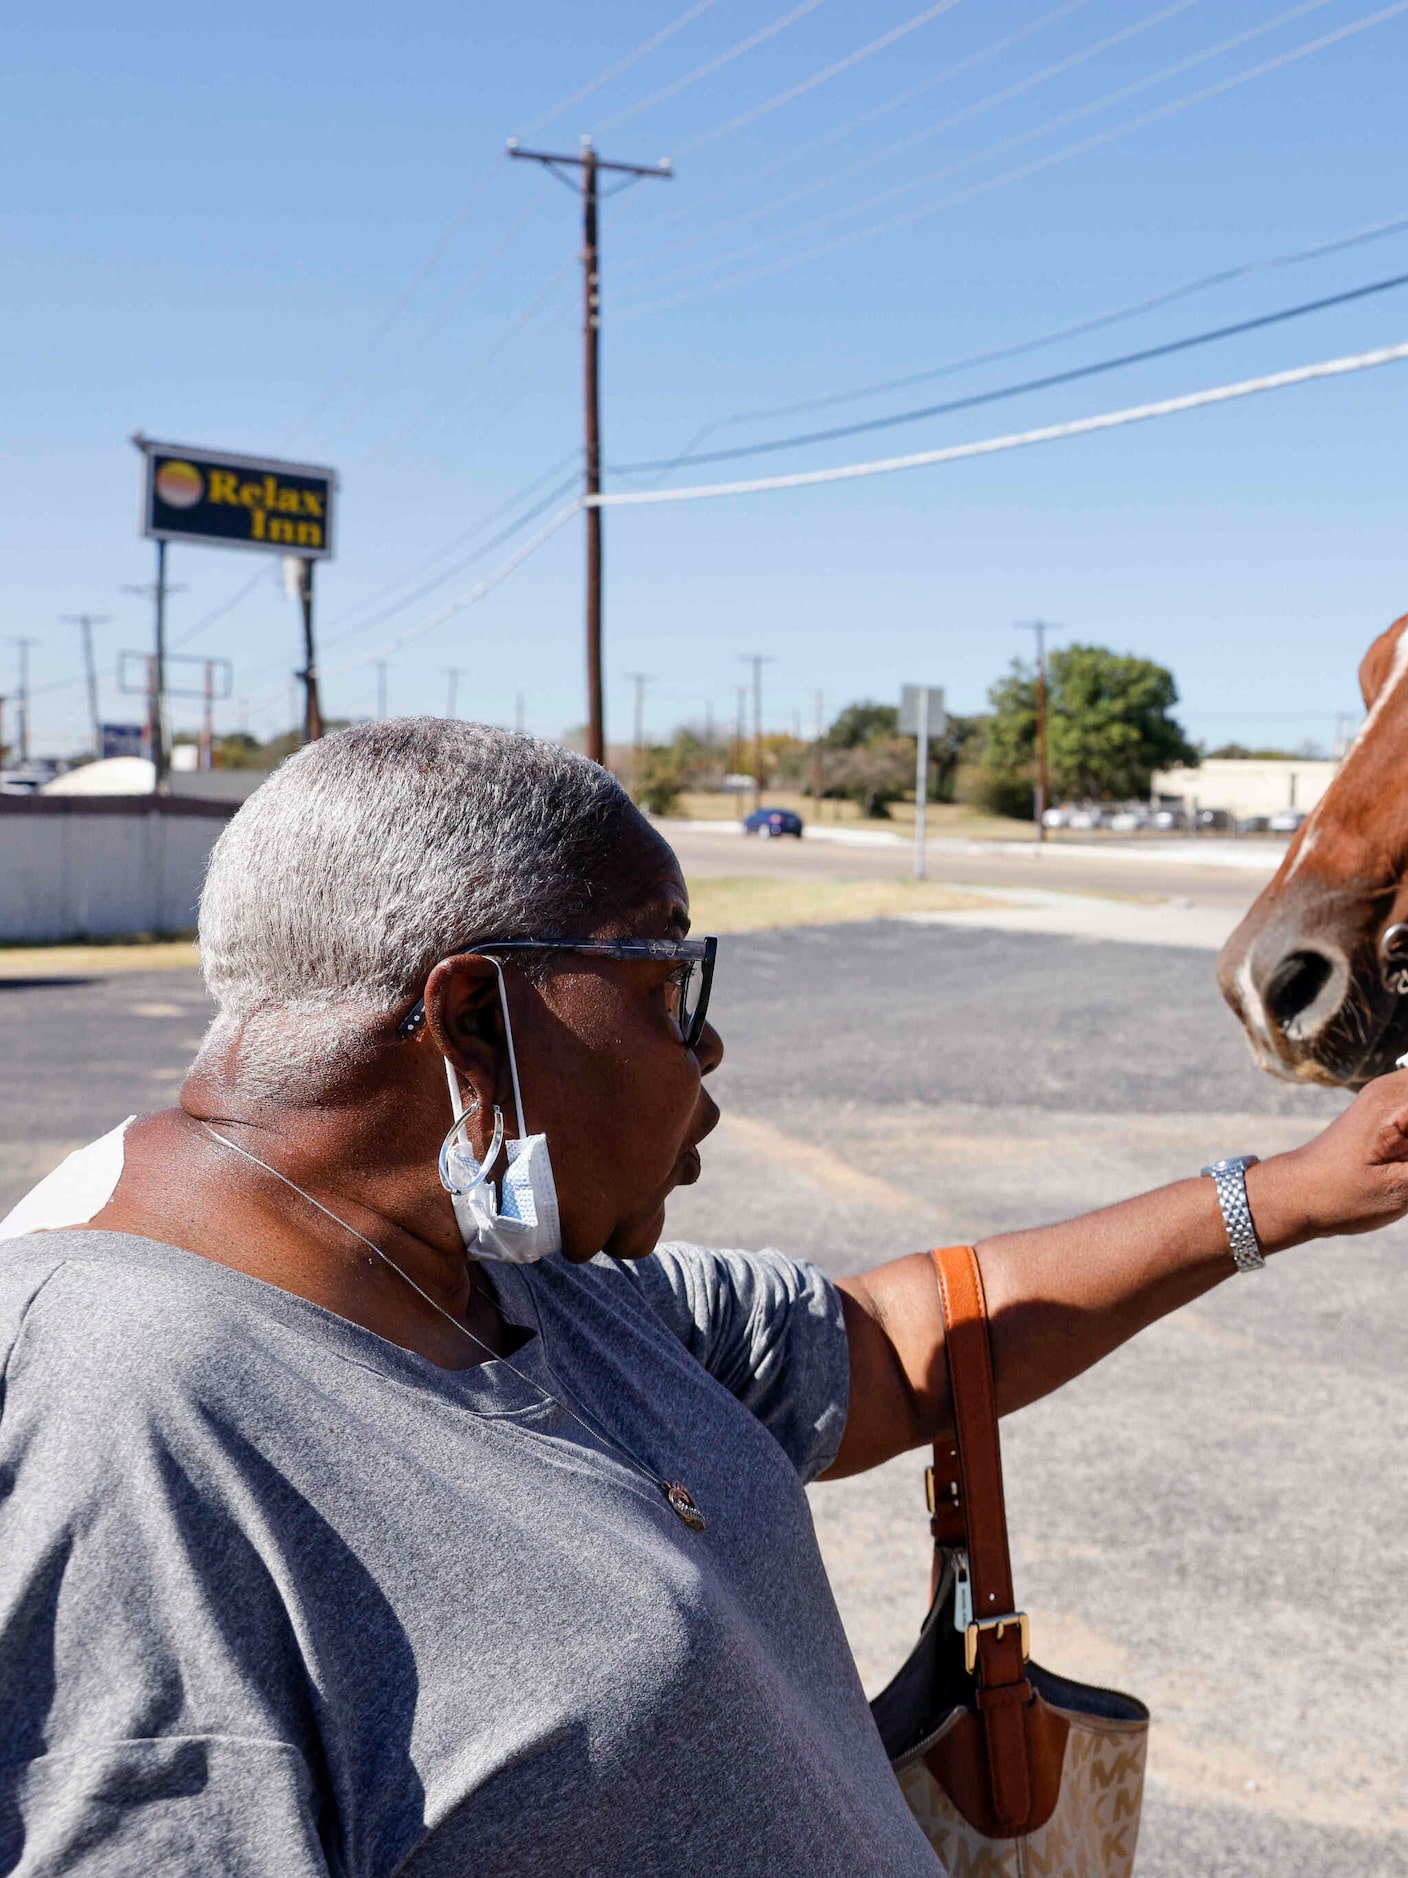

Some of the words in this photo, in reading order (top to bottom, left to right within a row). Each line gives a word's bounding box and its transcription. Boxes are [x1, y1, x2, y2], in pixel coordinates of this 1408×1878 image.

[208, 469, 323, 517] Relax
[251, 508, 322, 546] Inn
[1090, 1743, 1142, 1793] MK
